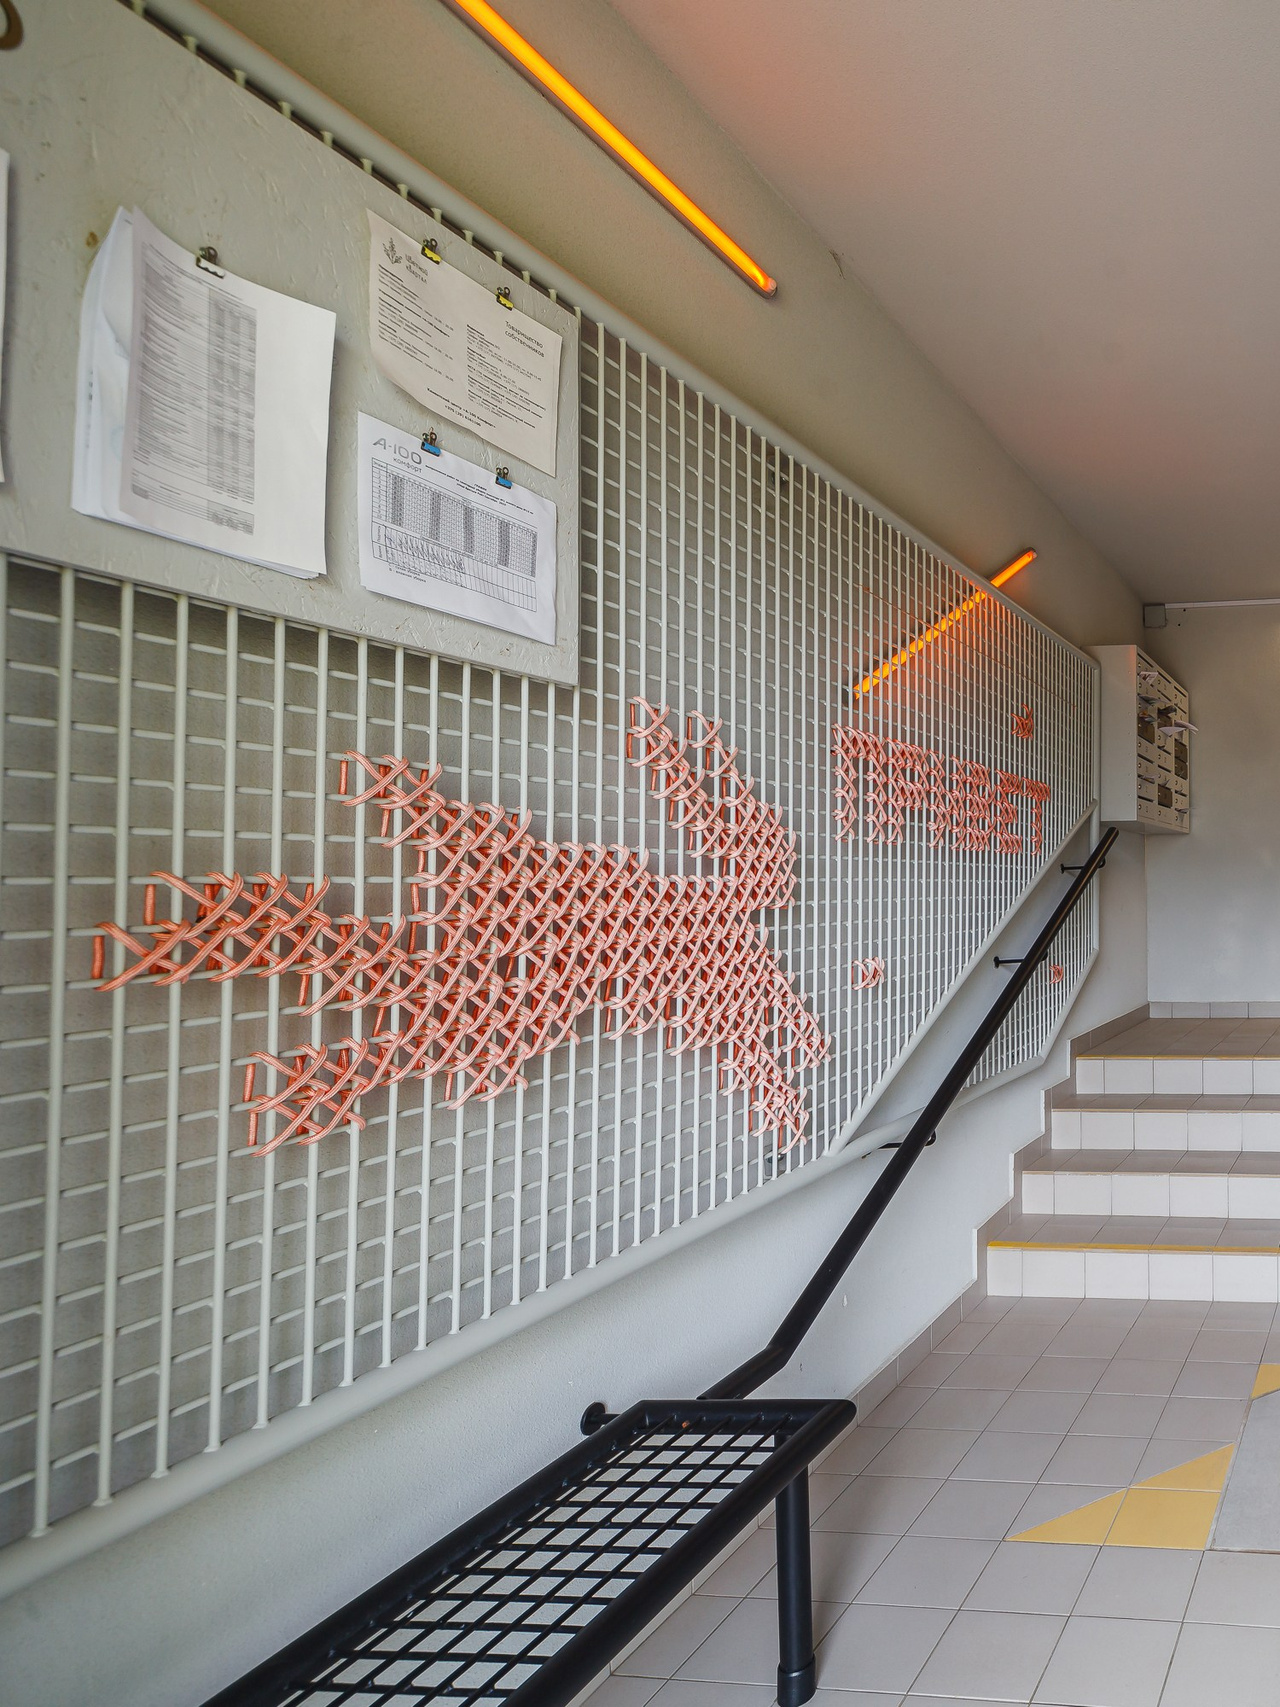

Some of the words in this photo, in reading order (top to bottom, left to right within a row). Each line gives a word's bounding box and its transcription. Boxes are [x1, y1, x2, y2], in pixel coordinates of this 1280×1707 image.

[505, 320, 544, 348] Товарищество
[505, 331, 545, 358] собственников
[393, 457, 422, 473] комфорт
[831, 723, 1051, 856] ПРИВЕТ
